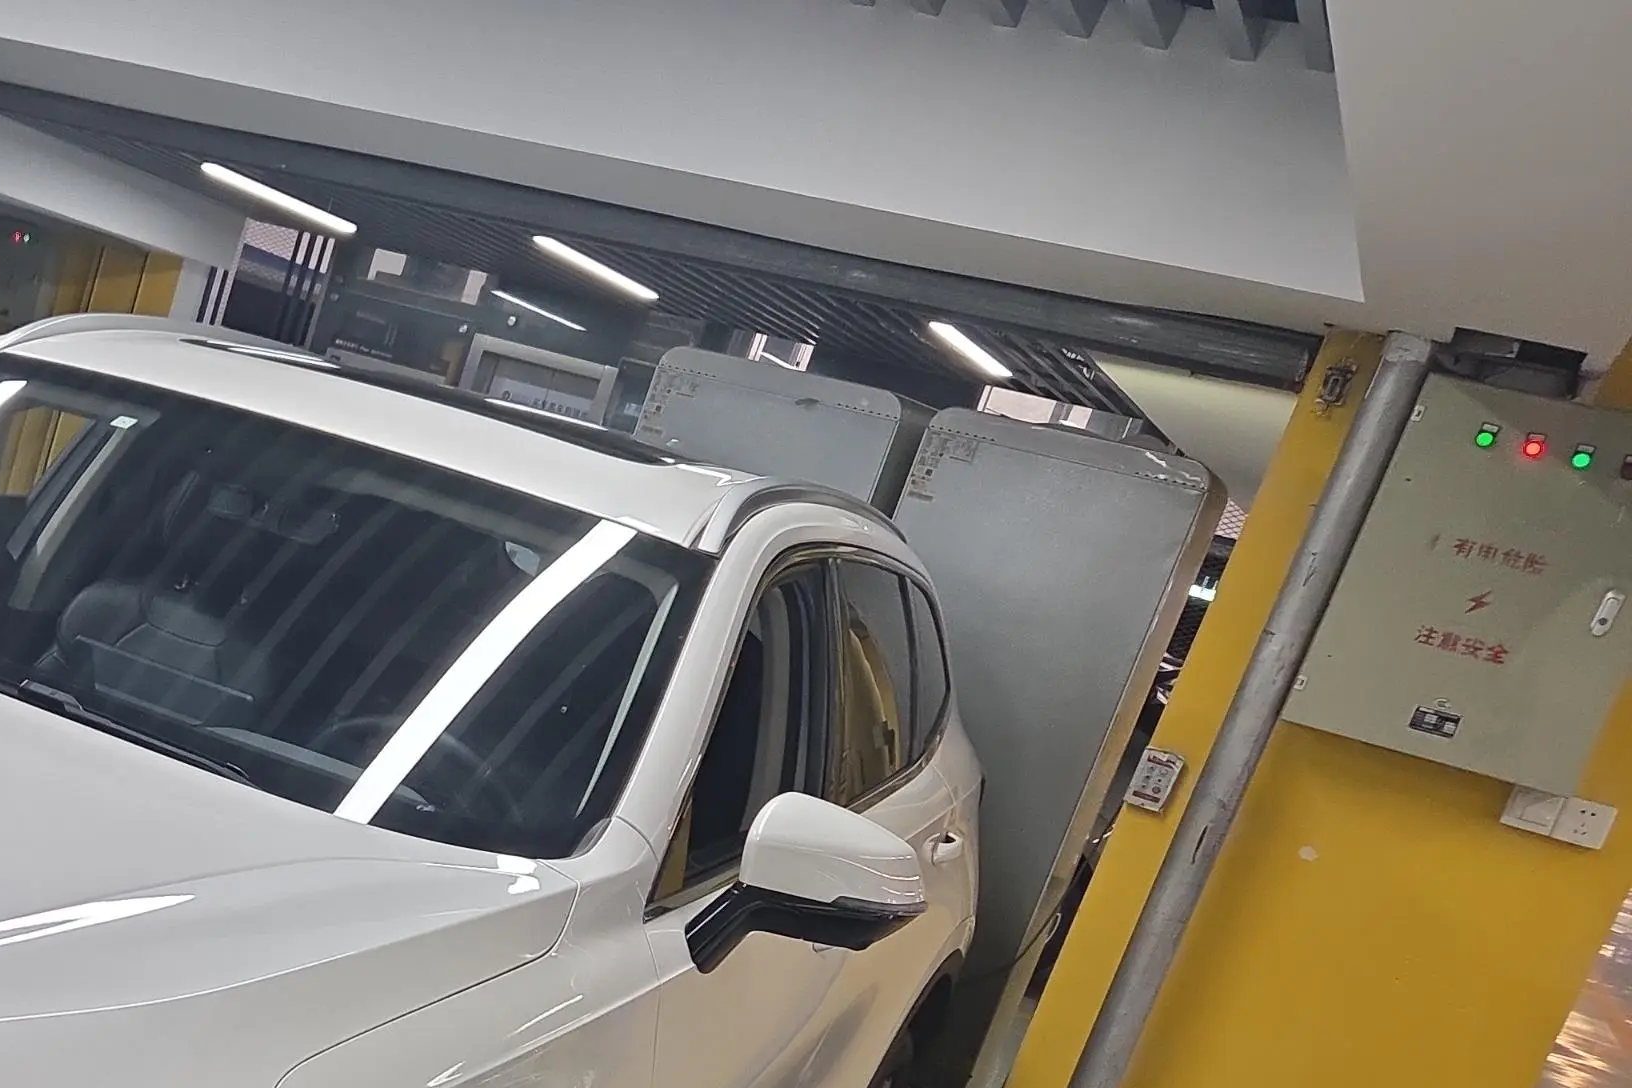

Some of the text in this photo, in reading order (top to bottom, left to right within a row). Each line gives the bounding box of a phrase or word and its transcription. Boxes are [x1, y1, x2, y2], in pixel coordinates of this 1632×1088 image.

[1452, 537, 1549, 575] 有电危险
[1414, 623, 1510, 665] 注意安全
